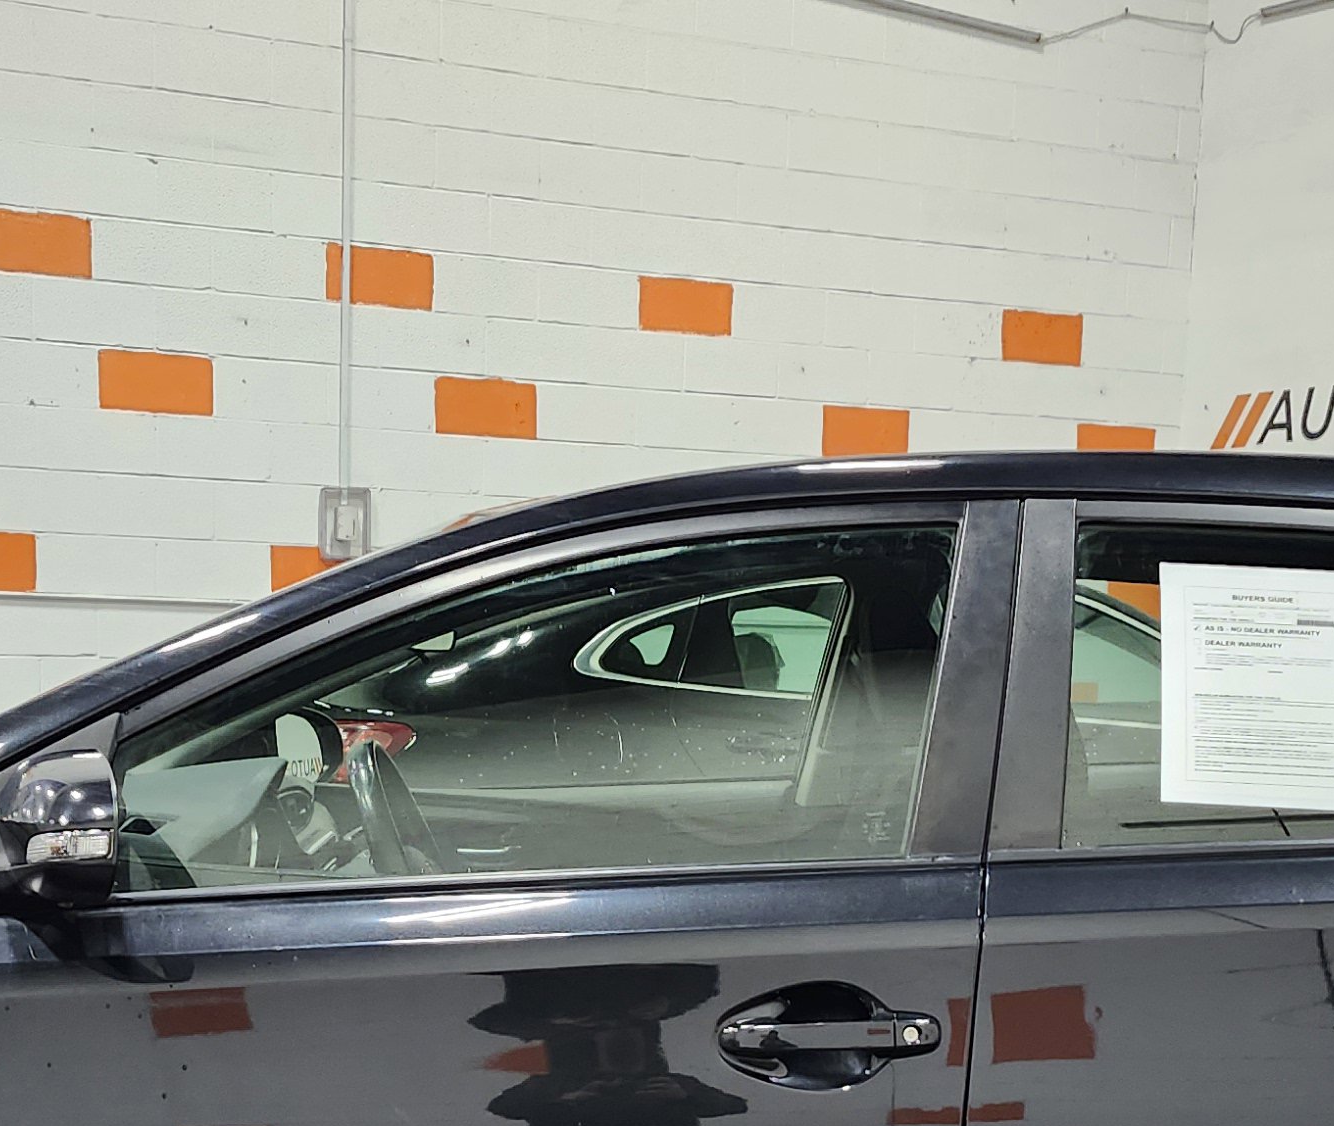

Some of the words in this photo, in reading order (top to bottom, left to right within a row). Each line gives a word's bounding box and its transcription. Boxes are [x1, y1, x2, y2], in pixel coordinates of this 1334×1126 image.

[1267, 596, 1294, 604] GUIDE
[1244, 627, 1275, 635] DEALER
[1277, 629, 1321, 637] WARRANTY
[1205, 639, 1236, 647] DEALER
[1238, 641, 1283, 649] WARRANTY
